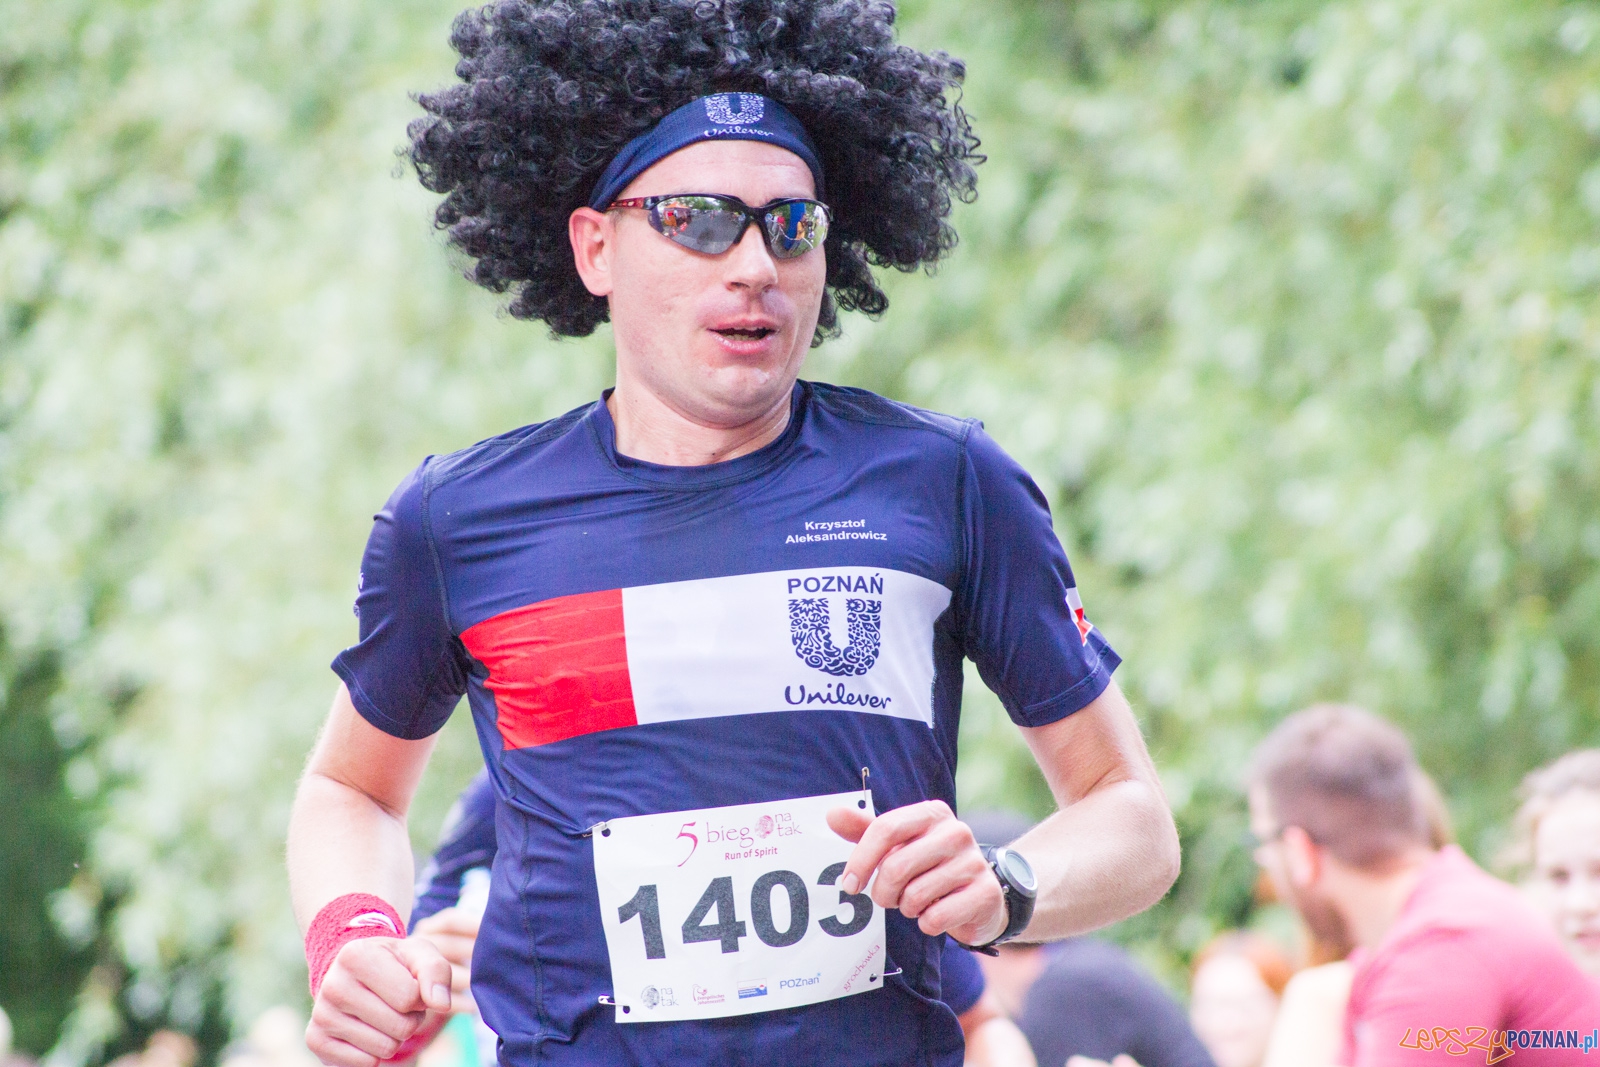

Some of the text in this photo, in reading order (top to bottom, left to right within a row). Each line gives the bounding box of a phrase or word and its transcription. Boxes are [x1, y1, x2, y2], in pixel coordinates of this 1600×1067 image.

[703, 126, 774, 137] Unilever
[805, 519, 866, 531] Krzysztof
[785, 530, 888, 544] Aleksandrowicz
[787, 573, 884, 595] POZNAŃ
[784, 682, 892, 710] Unilever
[774, 812, 792, 823] na
[777, 822, 803, 837] tak
[676, 821, 754, 867] 5 bieg
[724, 846, 778, 860] Run of Spirit
[617, 861, 874, 960] 1403
[660, 994, 679, 1006] tak
